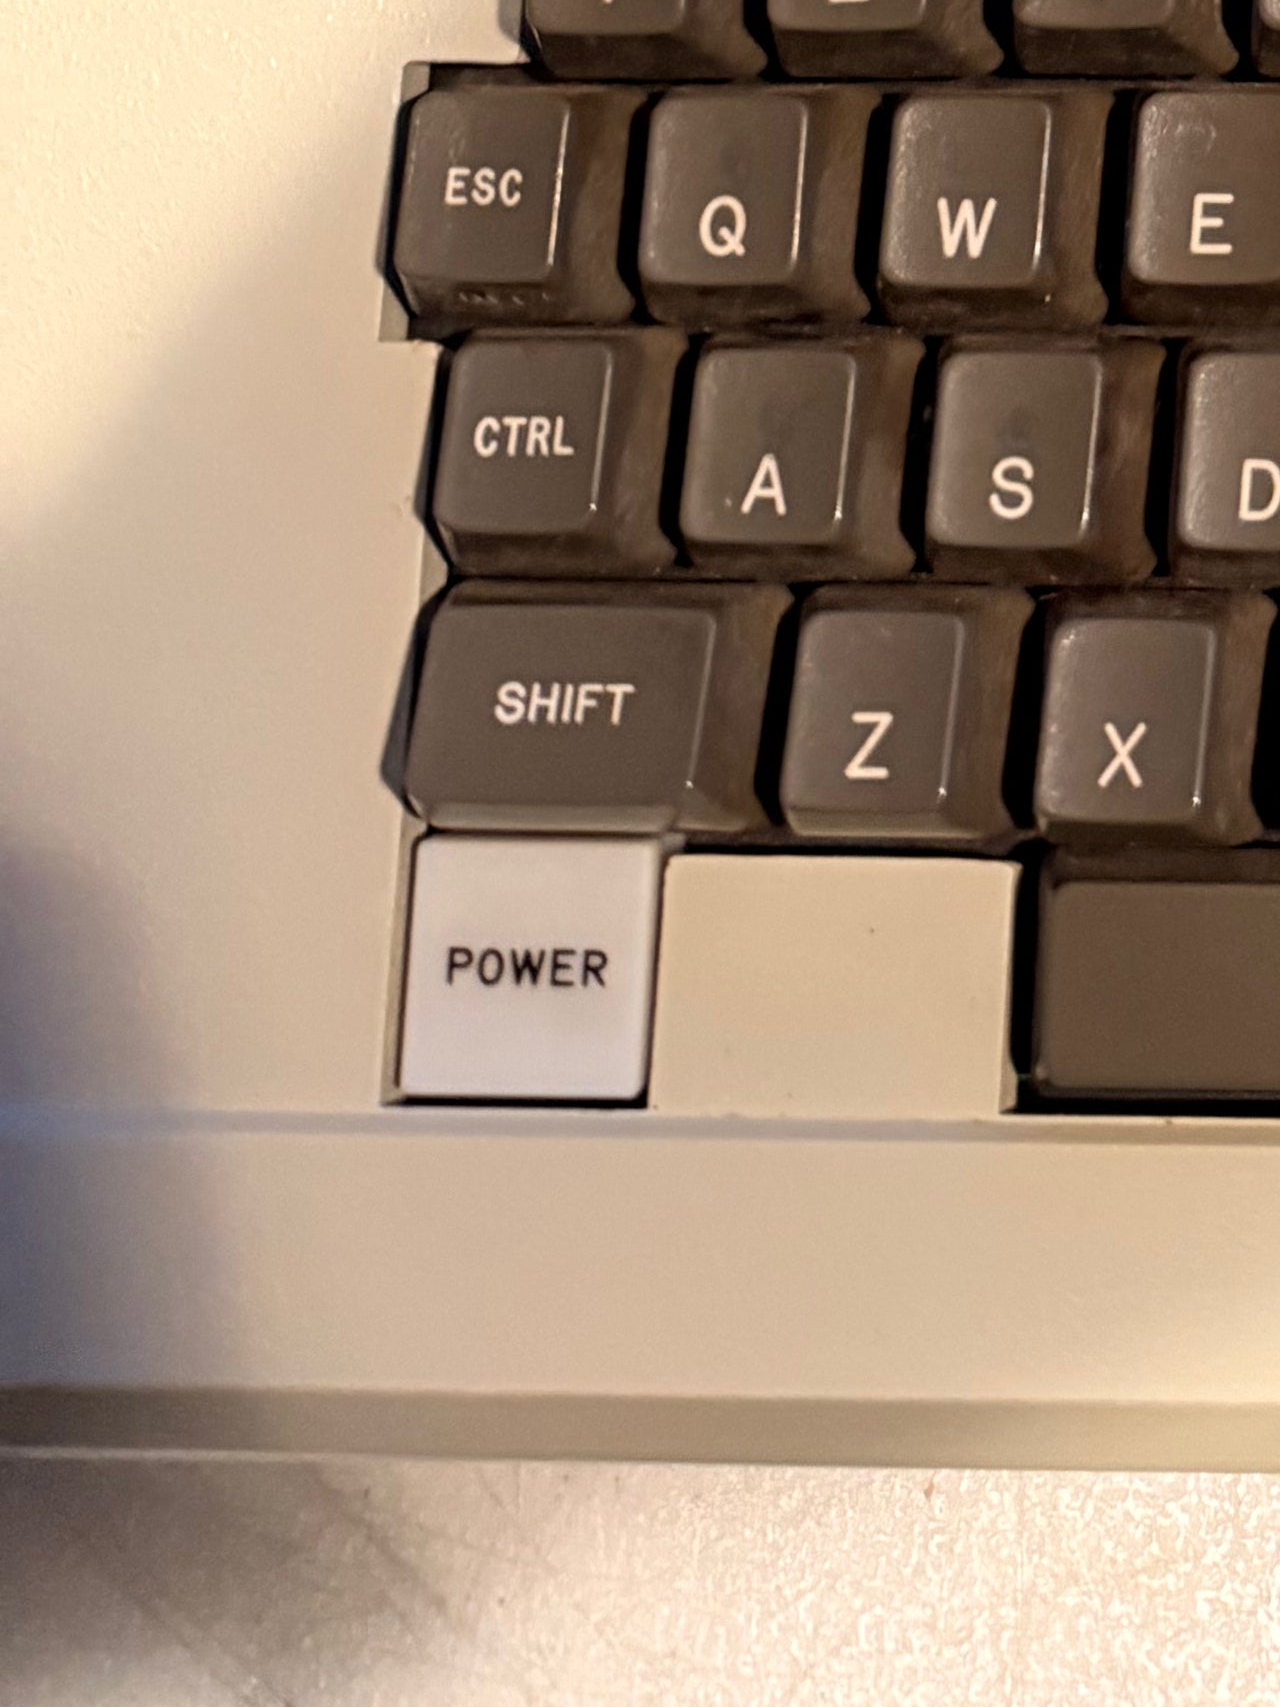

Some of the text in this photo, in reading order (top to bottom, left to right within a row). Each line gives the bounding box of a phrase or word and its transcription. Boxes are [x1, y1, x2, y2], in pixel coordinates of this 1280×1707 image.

[445, 166, 524, 207] ESC
[699, 195, 748, 258] Q
[936, 197, 998, 259] W
[1189, 193, 1234, 255] E
[473, 416, 574, 459] CTRL
[741, 454, 787, 516] A
[988, 456, 1035, 521] S
[494, 680, 635, 726] SHIFT
[845, 712, 894, 780] Z
[1097, 721, 1148, 788] X
[445, 947, 609, 987] POWER
